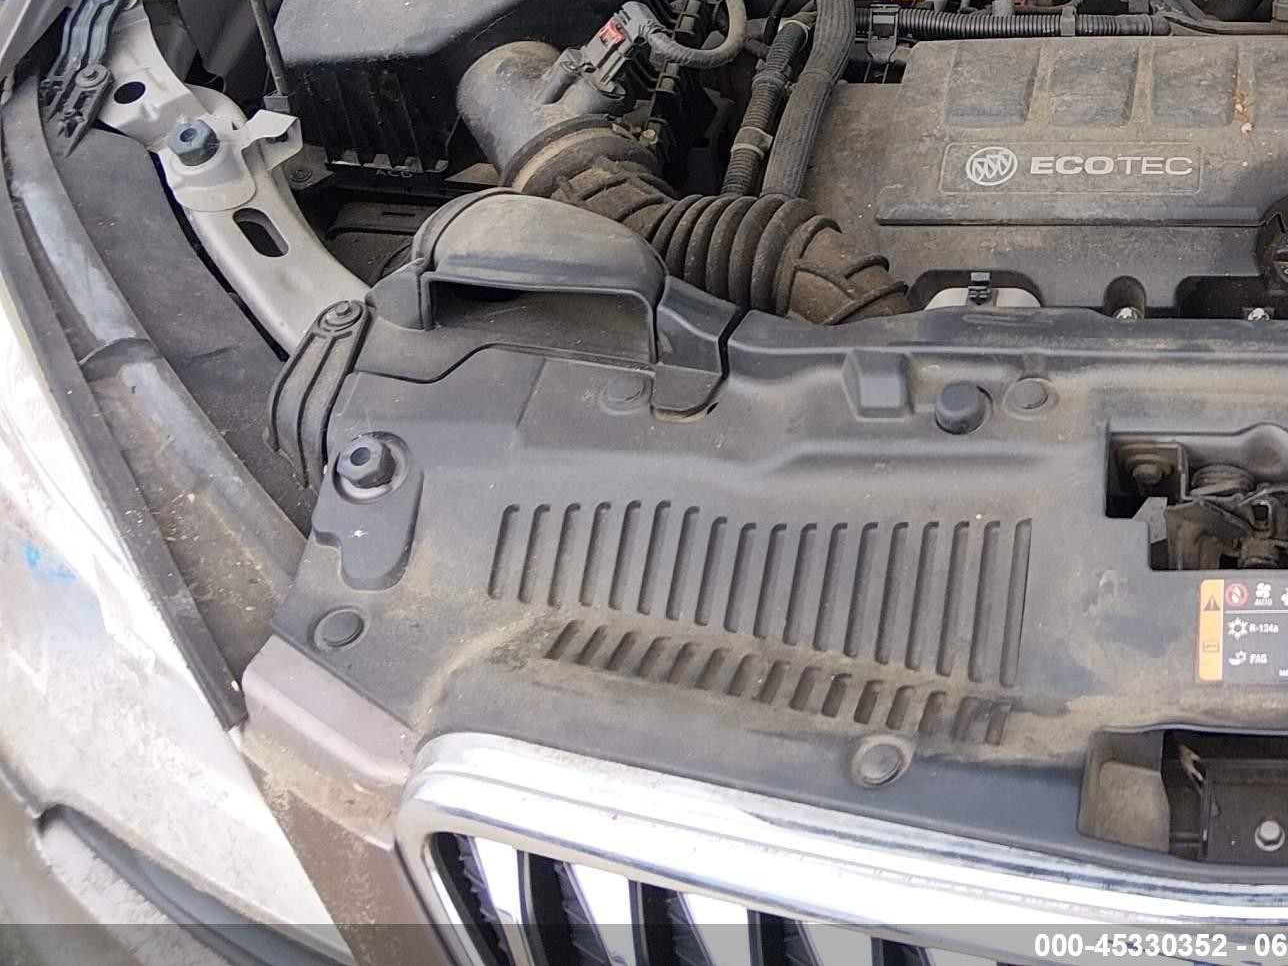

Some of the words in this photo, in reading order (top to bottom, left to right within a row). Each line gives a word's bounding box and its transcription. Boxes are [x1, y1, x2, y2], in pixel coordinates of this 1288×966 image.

[1030, 155, 1193, 175] ECOTEC
[1249, 623, 1279, 633] R-134a
[1249, 653, 1268, 664] PAG
